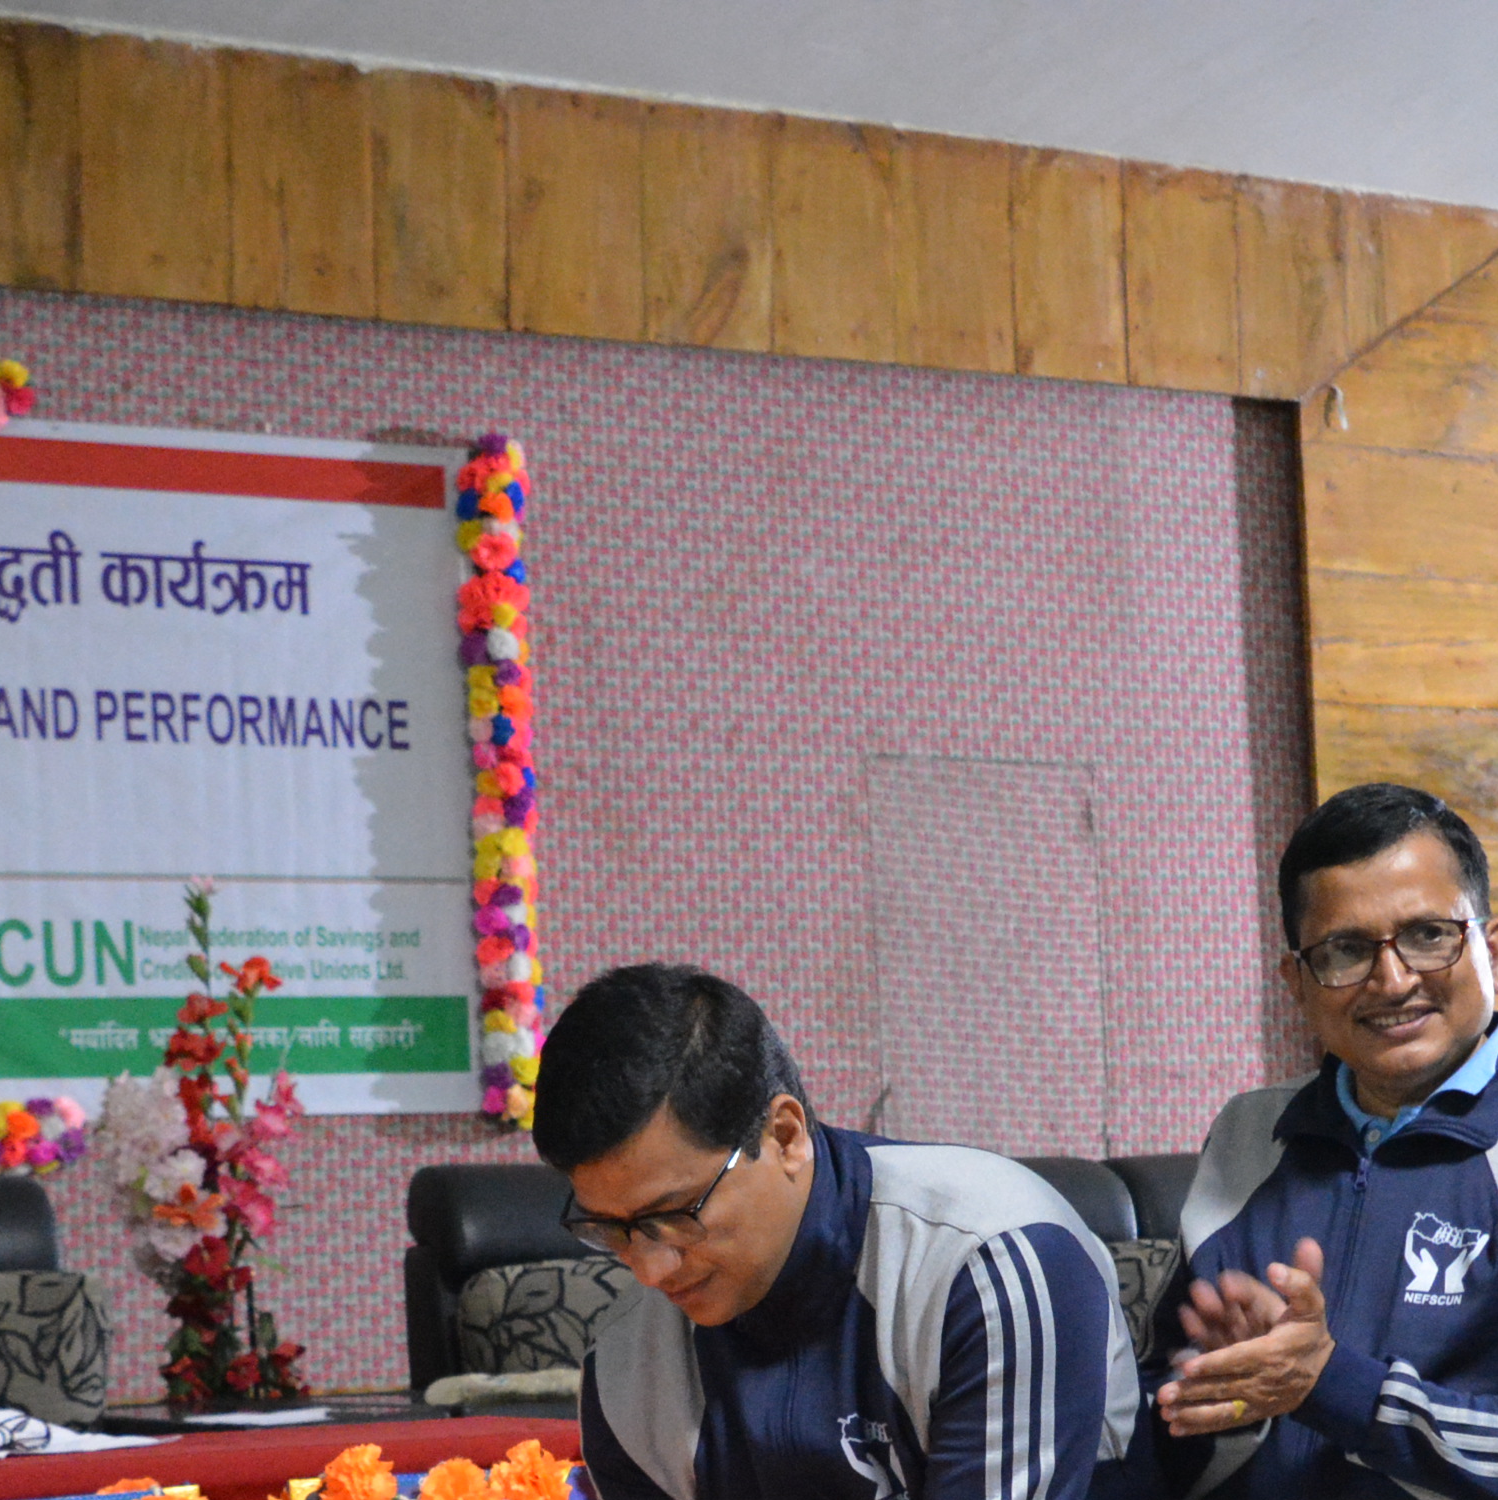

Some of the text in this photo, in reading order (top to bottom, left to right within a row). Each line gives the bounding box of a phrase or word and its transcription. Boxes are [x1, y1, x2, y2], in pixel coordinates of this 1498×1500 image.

[100, 540, 312, 616] कार्यक्रम
[94, 689, 412, 752] PERFORMANCE
[207, 927, 289, 948] ederation
[294, 927, 312, 948] of
[316, 926, 384, 952] Savings
[389, 930, 420, 949] and
[140, 959, 195, 981] Credi
[311, 960, 370, 981] Unions
[1404, 1292, 1462, 1305] NEFSCUN
